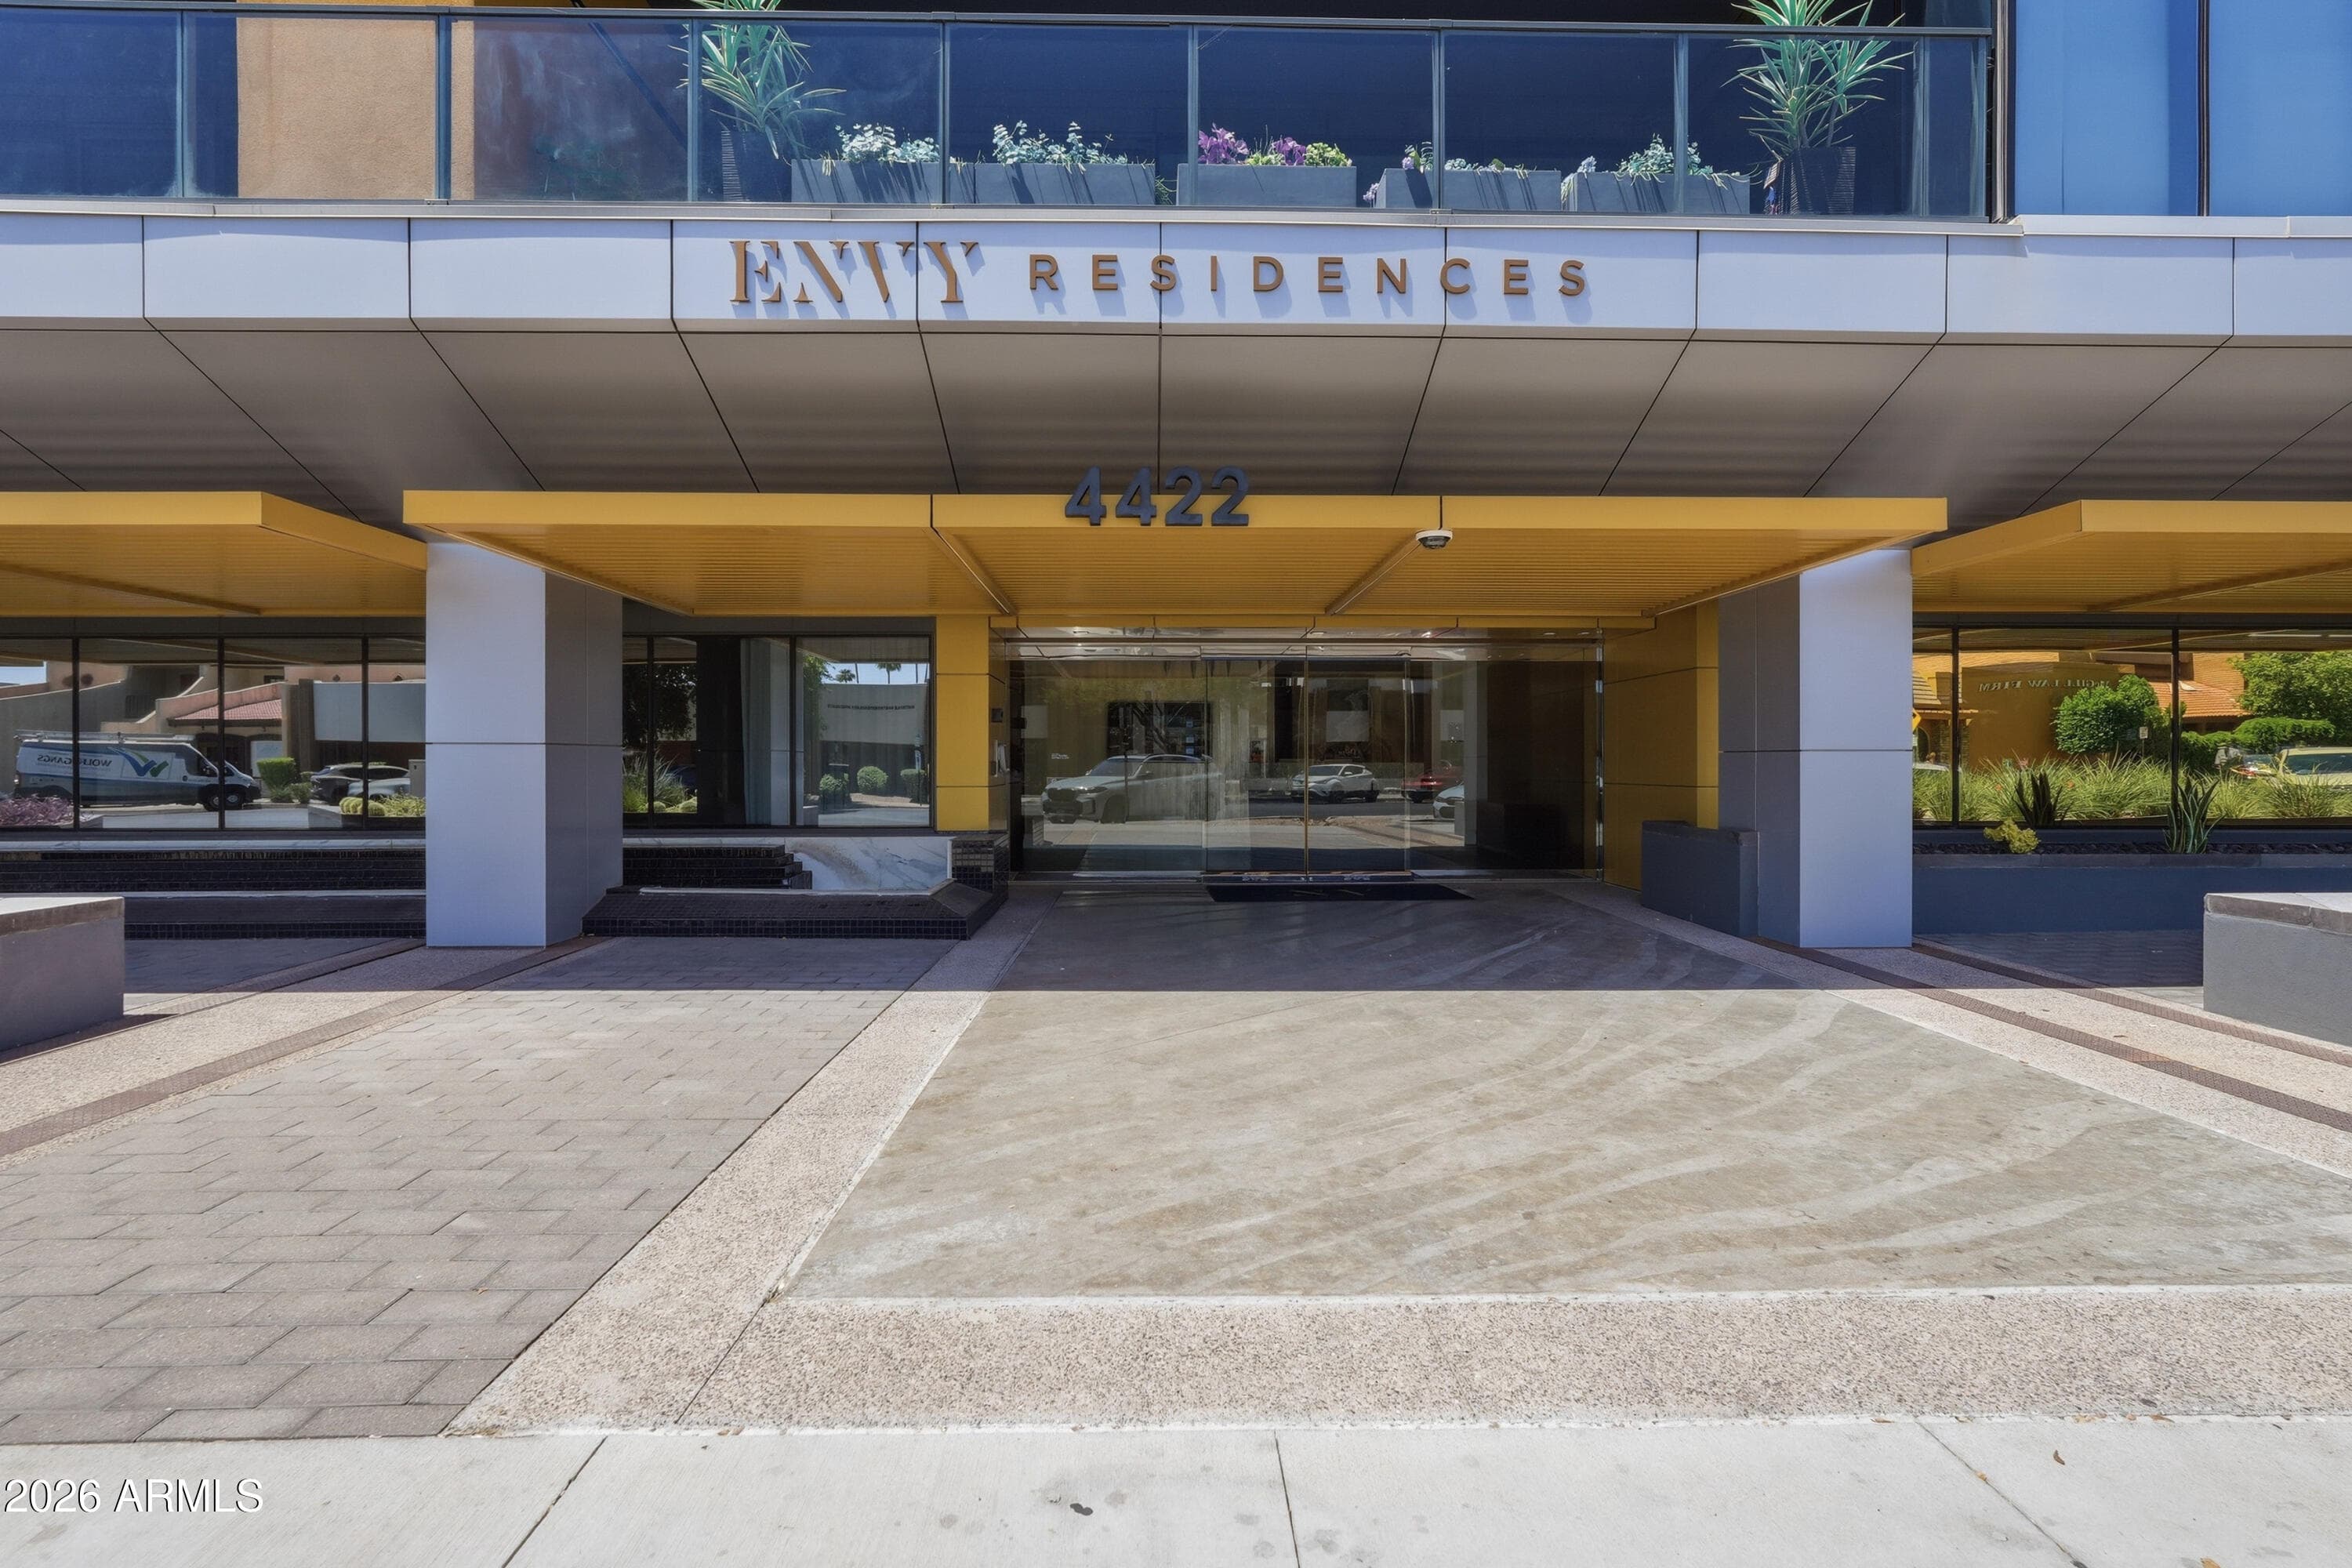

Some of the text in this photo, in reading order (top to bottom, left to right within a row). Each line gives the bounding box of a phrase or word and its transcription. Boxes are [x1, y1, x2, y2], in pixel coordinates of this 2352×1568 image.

[729, 241, 1584, 303] ENVY RESIDENCES
[1065, 465, 1249, 526] 4422
